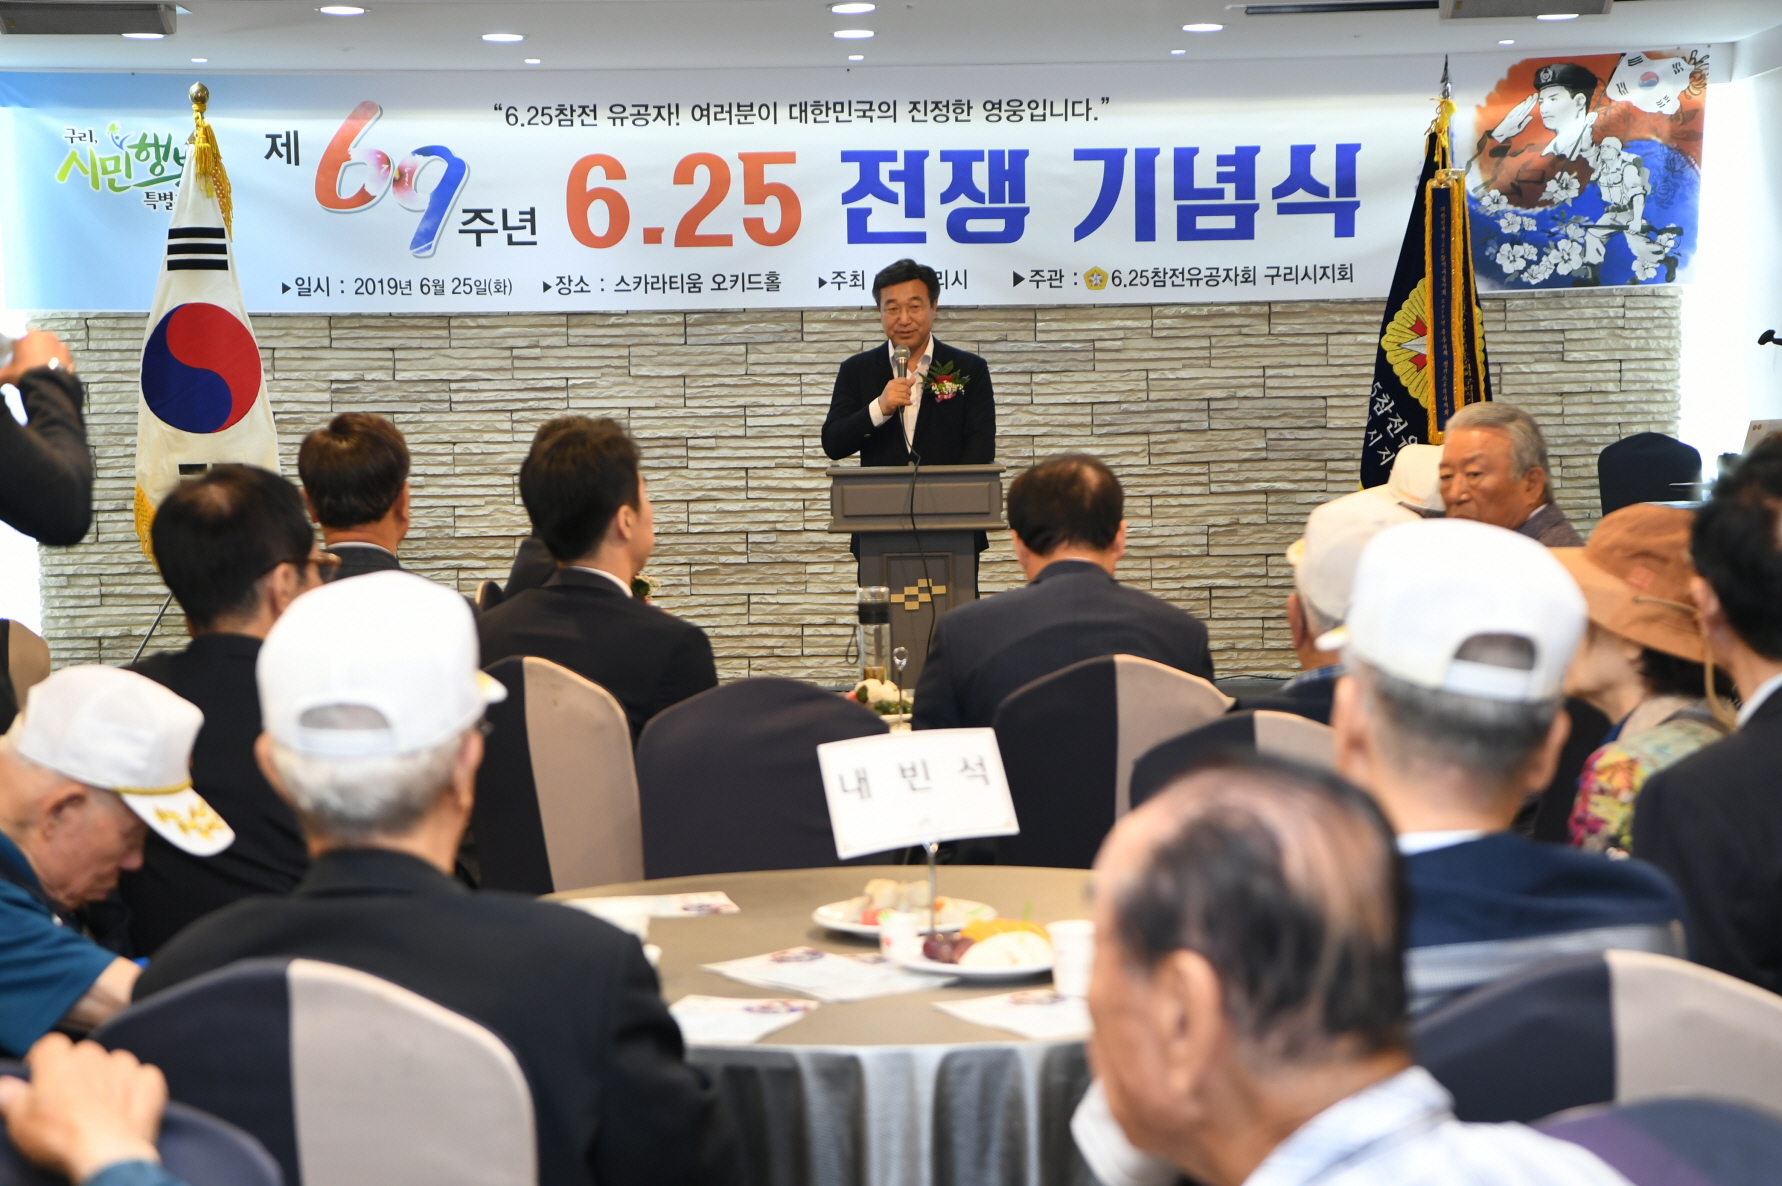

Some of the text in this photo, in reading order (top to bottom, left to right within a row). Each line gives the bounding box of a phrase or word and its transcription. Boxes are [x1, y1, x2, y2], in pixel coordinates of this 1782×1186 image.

[606, 102, 680, 127] 유공자!
[690, 100, 778, 126] 여러분이
[788, 99, 897, 125] 대한민국의
[907, 98, 974, 124] 진정한
[143, 191, 178, 211] 특별
[566, 151, 802, 249] 6.25
[840, 148, 1031, 245] 전쟁
[1073, 143, 1362, 243] 기념식
[294, 276, 330, 297] 일시
[354, 277, 412, 296] 2019년
[419, 277, 445, 296] 6월
[451, 276, 513, 297] 25일(화)
[555, 274, 592, 296] 장소
[613, 273, 704, 295] 스카라티움
[710, 270, 782, 293] 오키드홀
[830, 269, 968, 291] 주최 리시
[1028, 268, 1065, 289] 주관
[1111, 265, 1257, 288] 6.25참전유공자회
[1264, 263, 1354, 286] 구리시지회
